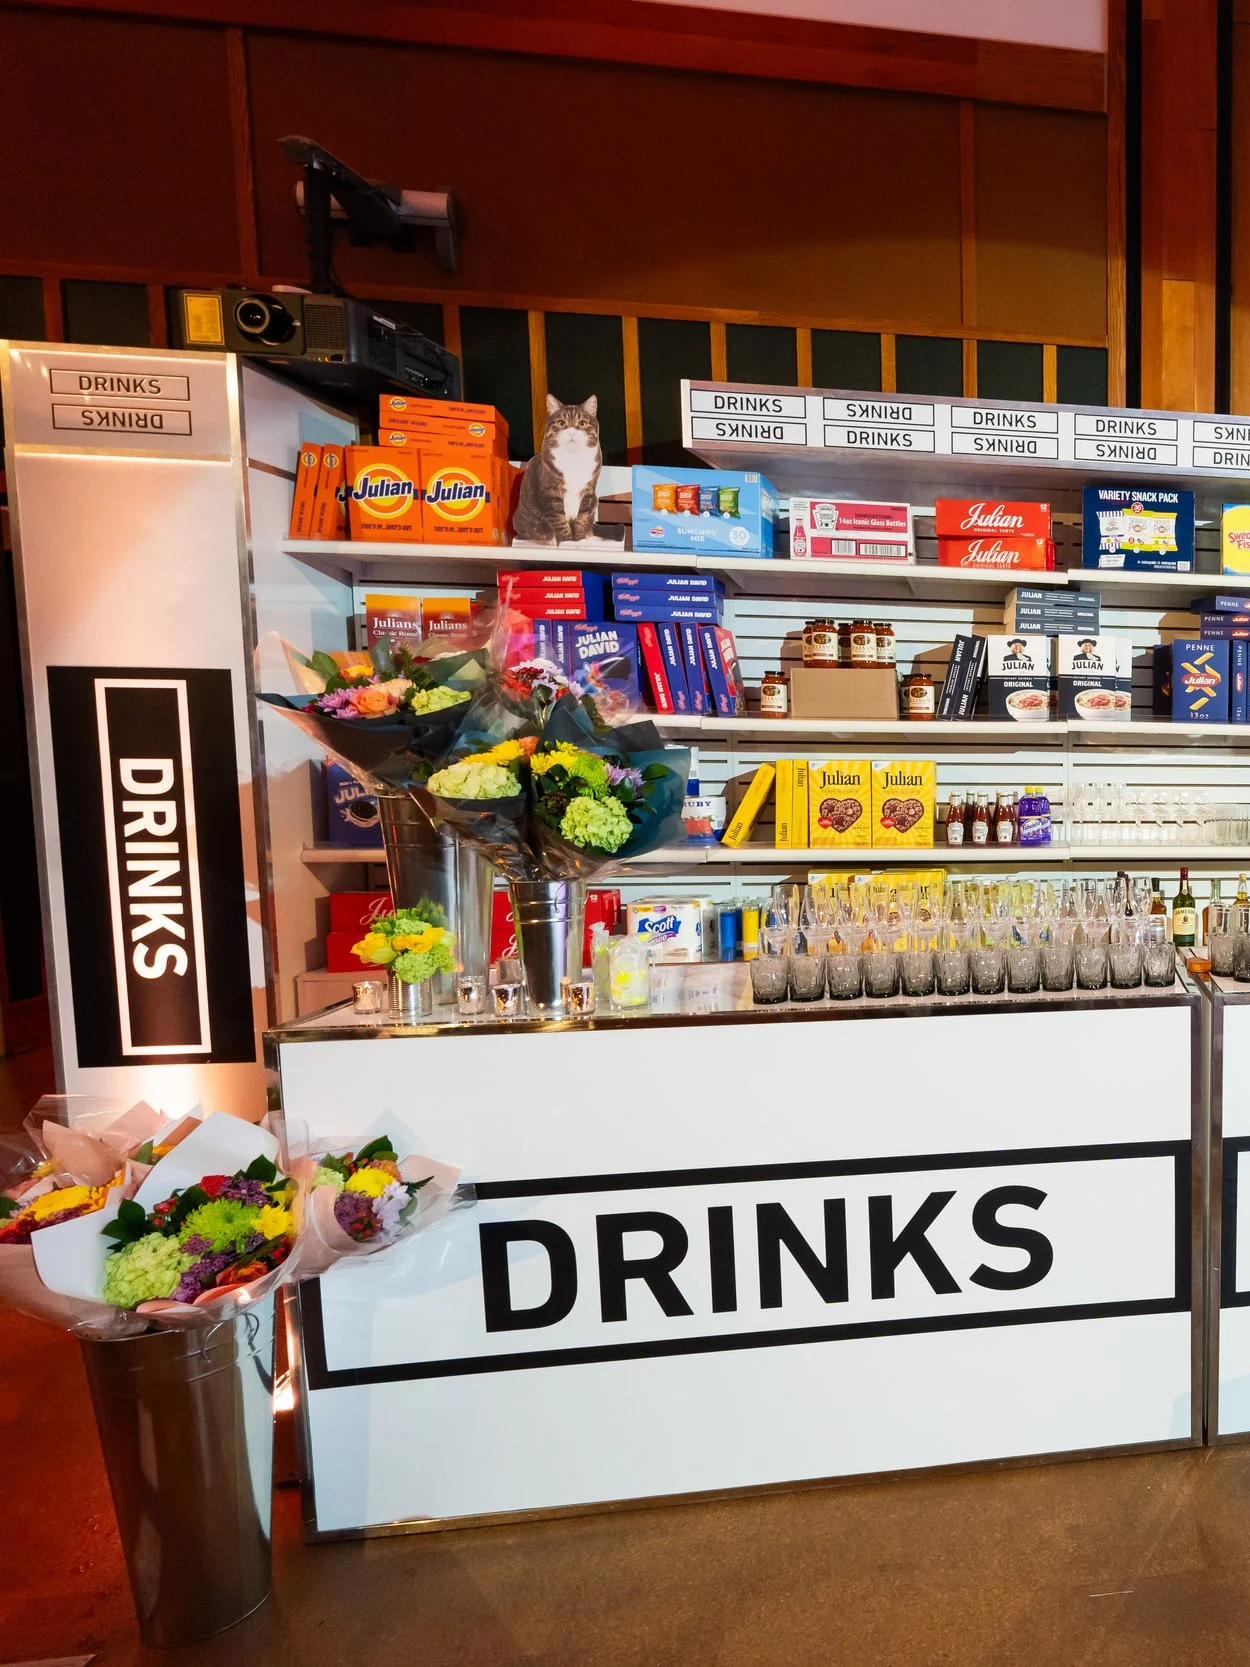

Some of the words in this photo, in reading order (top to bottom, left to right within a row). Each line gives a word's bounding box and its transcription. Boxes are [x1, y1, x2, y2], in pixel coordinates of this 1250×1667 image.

[79, 375, 161, 396] DRINKS
[714, 395, 782, 414] DRINKS
[847, 403, 912, 421] DRINKS
[81, 409, 163, 430] DRINKS
[973, 412, 1037, 429] DRINKS
[1096, 420, 1157, 436] DRINKS
[716, 423, 783, 440] DRINKS
[847, 430, 912, 447] DRINKS
[974, 438, 1037, 454] DRINKS
[1096, 445, 1156, 460] DRINKS
[352, 476, 413, 500] Julian
[426, 480, 485, 504] Julian
[1098, 490, 1130, 501] VARIETY
[1132, 491, 1158, 502] SNACK
[1158, 492, 1178, 504] PACK
[960, 503, 1024, 530] Julian
[731, 530, 747, 540] 30
[960, 540, 1020, 566] Julian
[1220, 600, 1239, 608] PENNE
[373, 617, 418, 630] Julians
[428, 620, 468, 632] Julians
[1019, 622, 1040, 630] JULIAN
[575, 630, 618, 648] JULIAN
[663, 628, 673, 646] DAVID
[704, 632, 714, 650] DAVID
[578, 640, 620, 660] DAVID
[954, 640, 965, 662] JULIAN
[1186, 644, 1215, 652] PENNE
[1002, 662, 1034, 672] JULIAN
[1072, 662, 1104, 671] JULIAN
[1072, 680, 1102, 688] ORIGINAL
[1184, 676, 1216, 686] Julian
[959, 694, 968, 716] JULIAN
[1190, 712, 1209, 720] 13oz
[798, 767, 806, 787] Julian
[820, 770, 861, 788] Julian
[882, 770, 922, 789] Julian
[728, 822, 743, 842] Julian
[780, 822, 788, 842] Julian
[119, 758, 188, 979] DRINKS
[644, 915, 674, 934] Scott
[479, 1184, 1055, 1333] DRINKS
